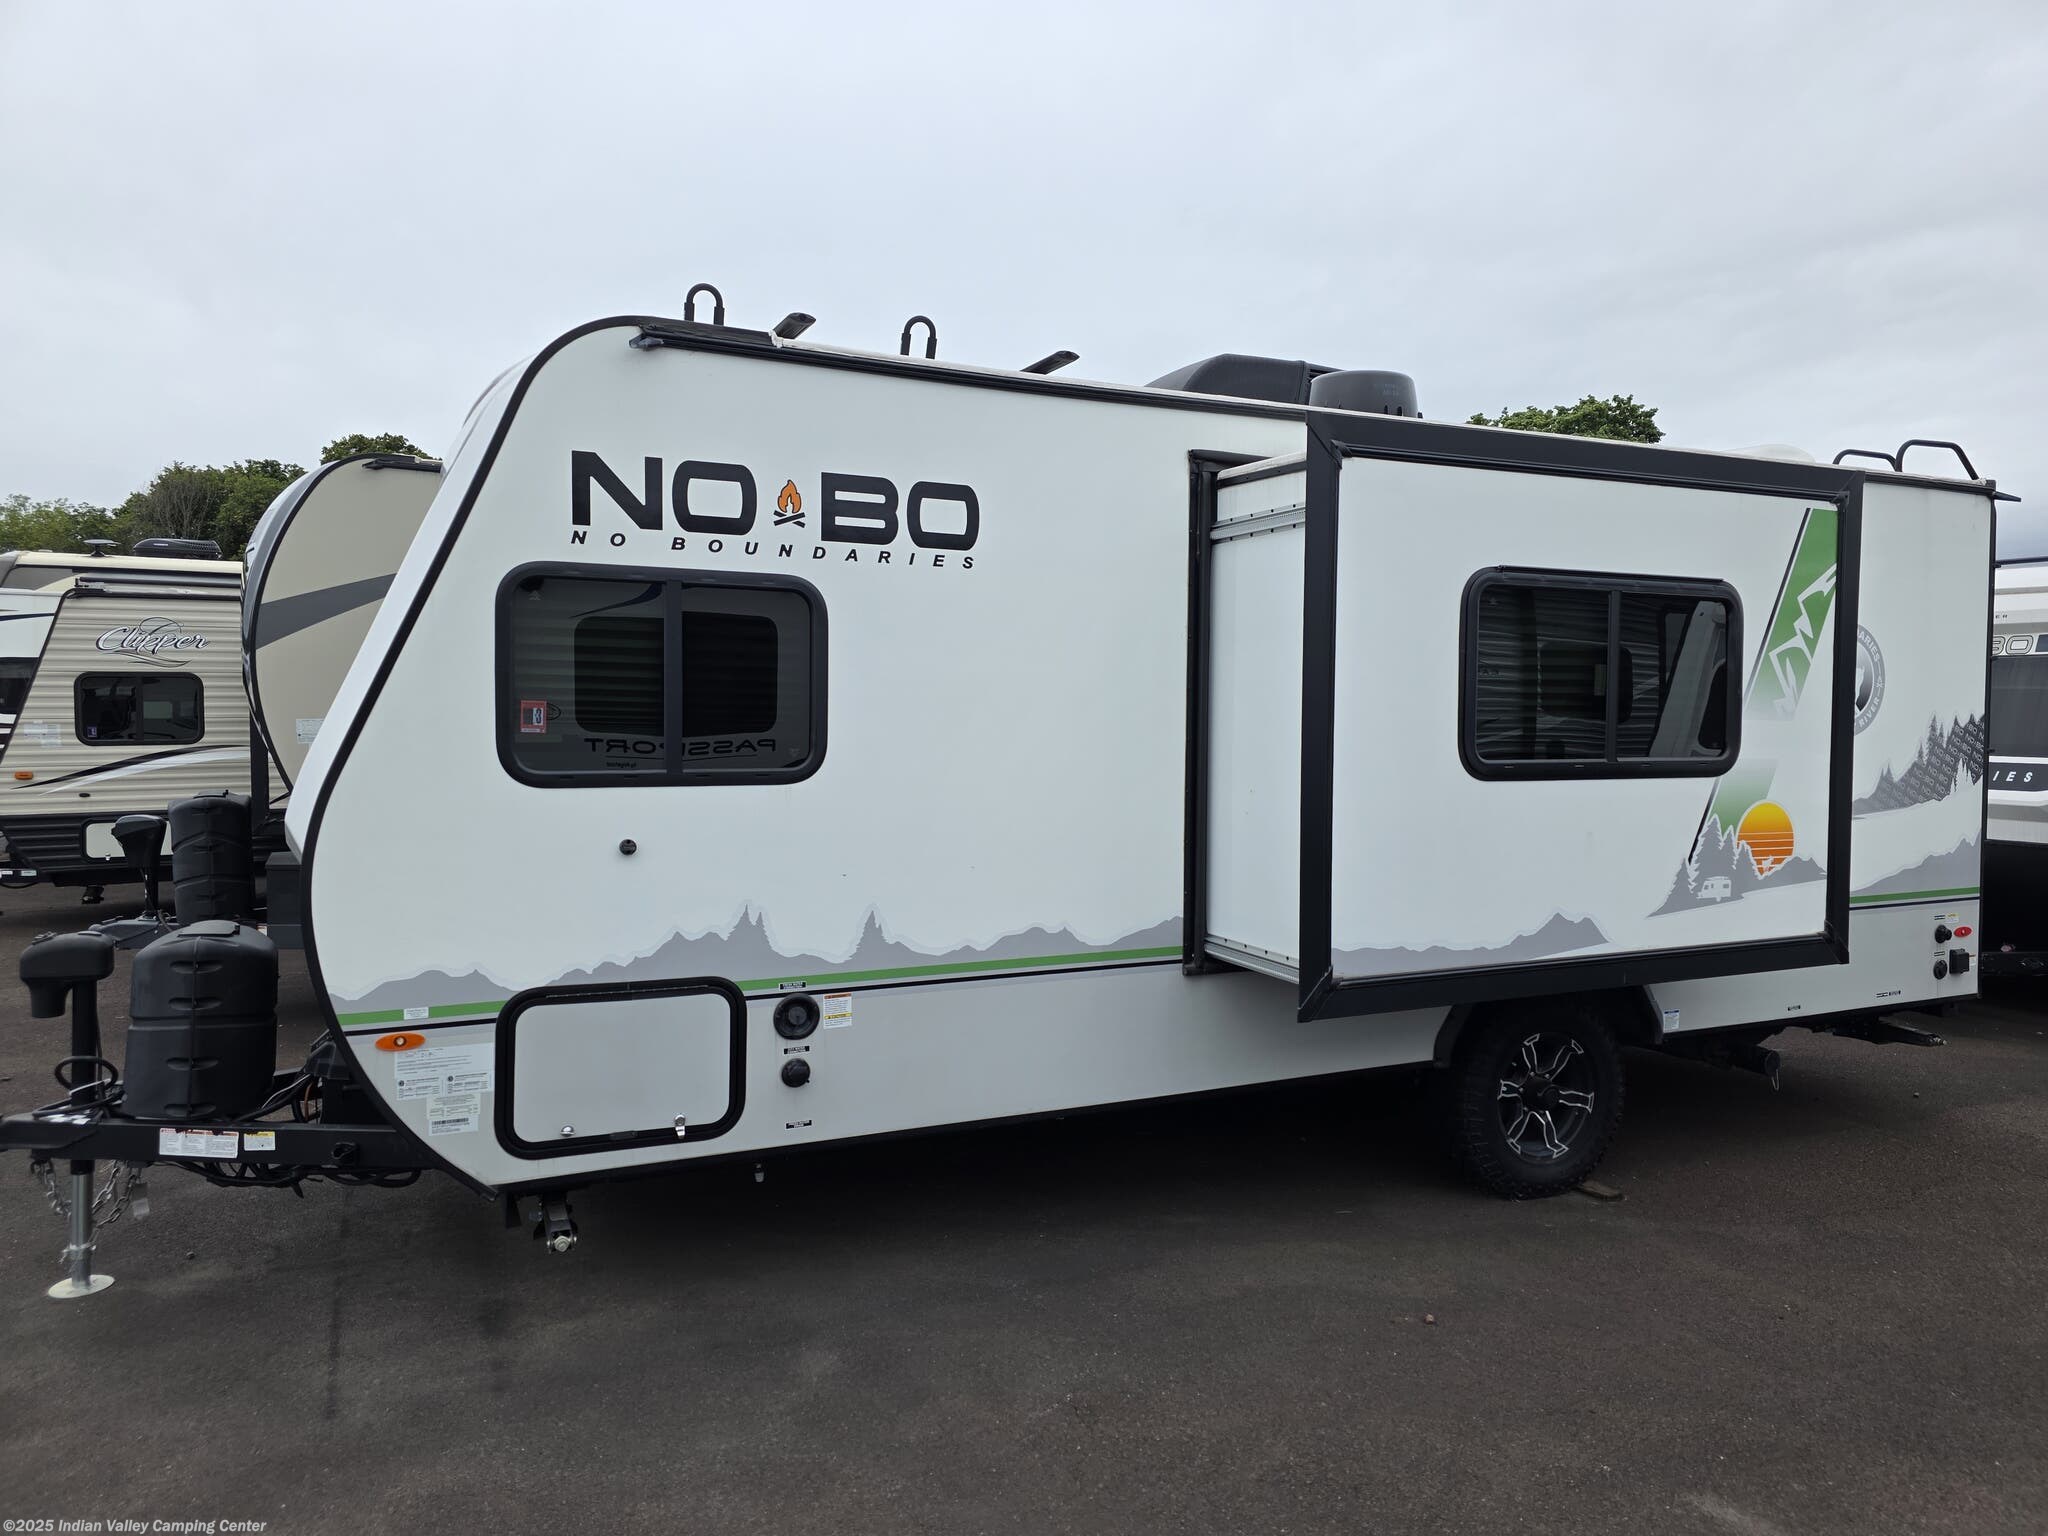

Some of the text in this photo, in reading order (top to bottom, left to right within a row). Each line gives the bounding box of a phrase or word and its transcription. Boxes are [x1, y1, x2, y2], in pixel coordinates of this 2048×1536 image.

[571, 450, 980, 551] NO BO
[570, 530, 975, 570] NO BOUNDARIES
[95, 625, 211, 656] Clipper
[1858, 631, 1881, 662] ARIES
[1859, 696, 1880, 728] RIVER
